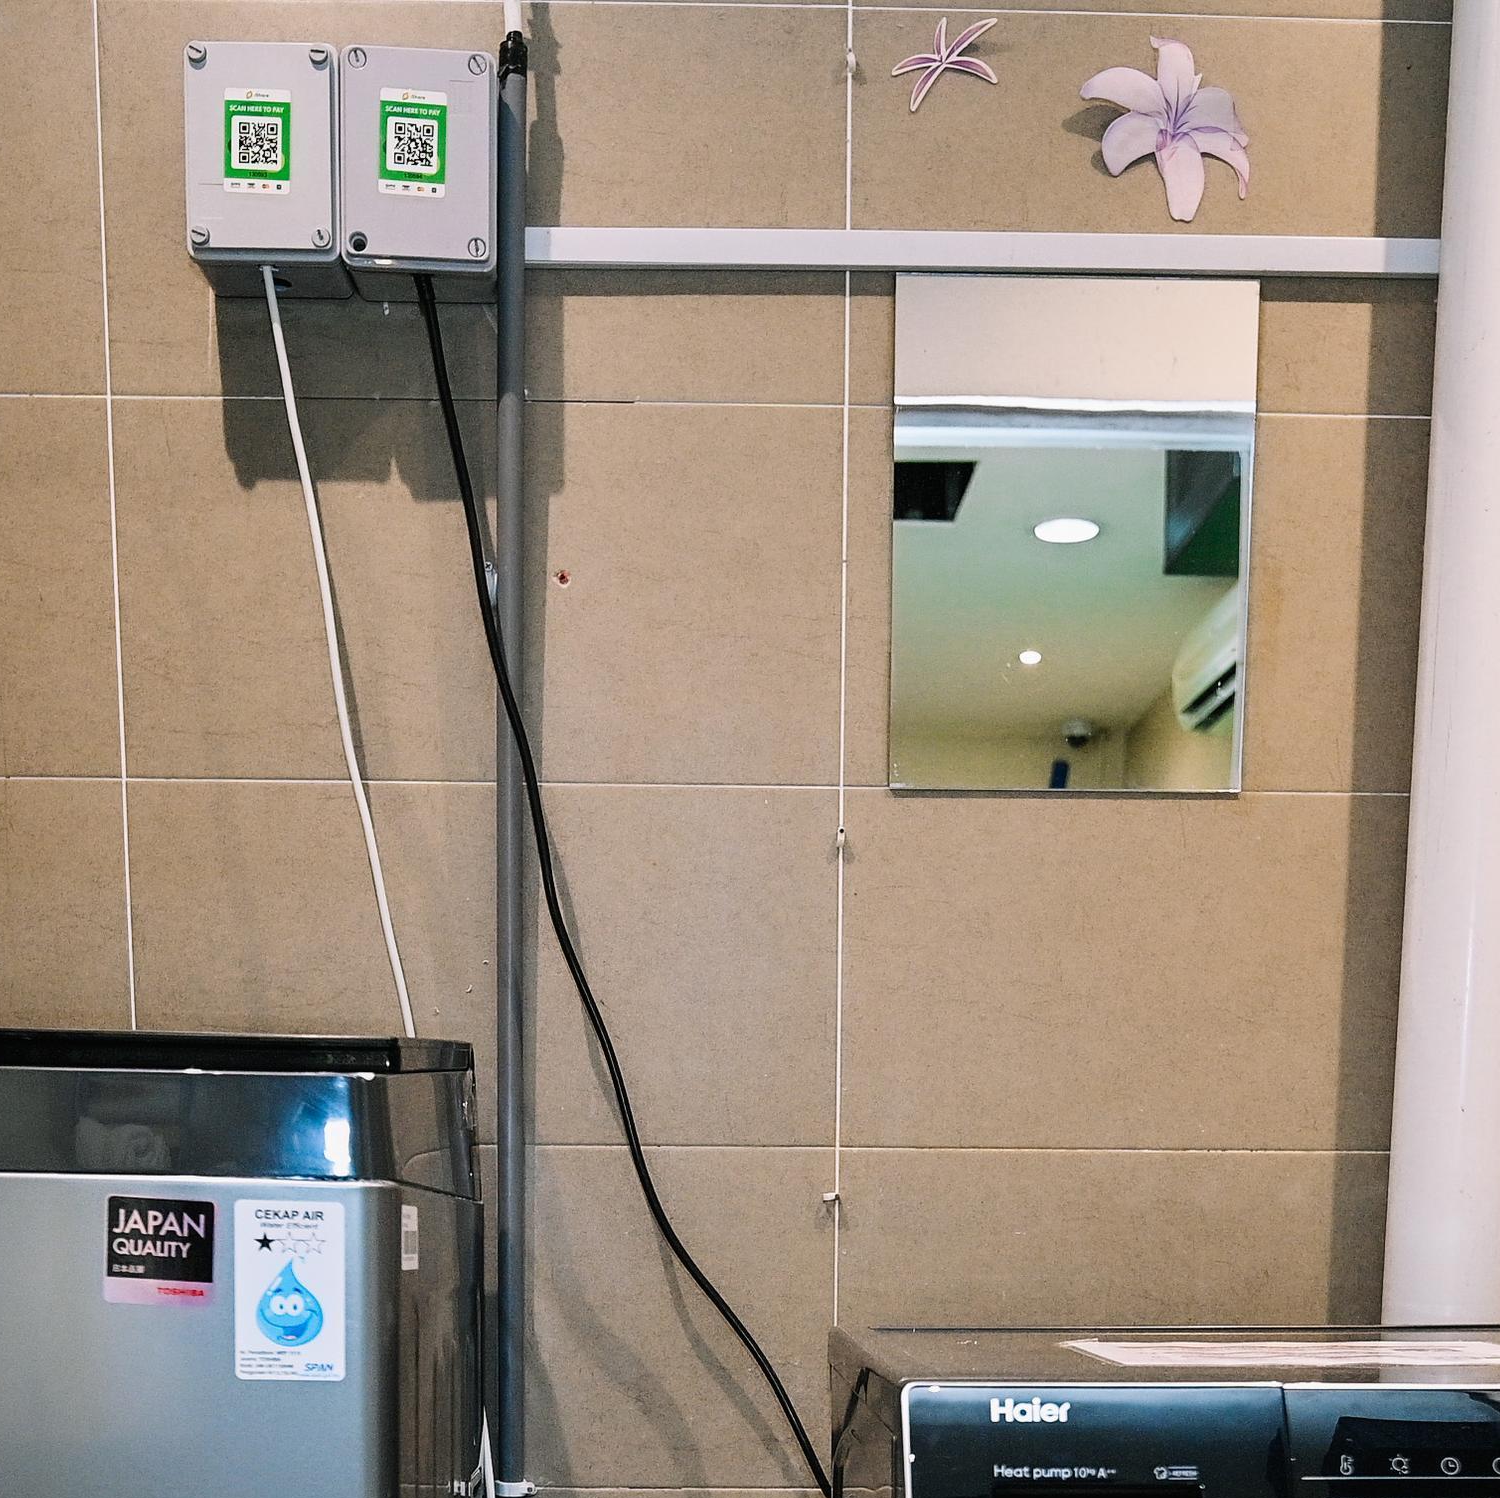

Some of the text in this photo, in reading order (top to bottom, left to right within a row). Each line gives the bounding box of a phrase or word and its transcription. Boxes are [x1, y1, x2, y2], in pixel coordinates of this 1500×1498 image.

[112, 1208, 205, 1239] JAPAN
[255, 1209, 324, 1221] CEKAP AIR
[112, 1238, 191, 1258] QUALITY
[157, 1287, 204, 1296] TOSHIBA
[990, 1398, 1071, 1423] Haier
[994, 1465, 1029, 1478] Heat
[1033, 1467, 1072, 1479] pump
